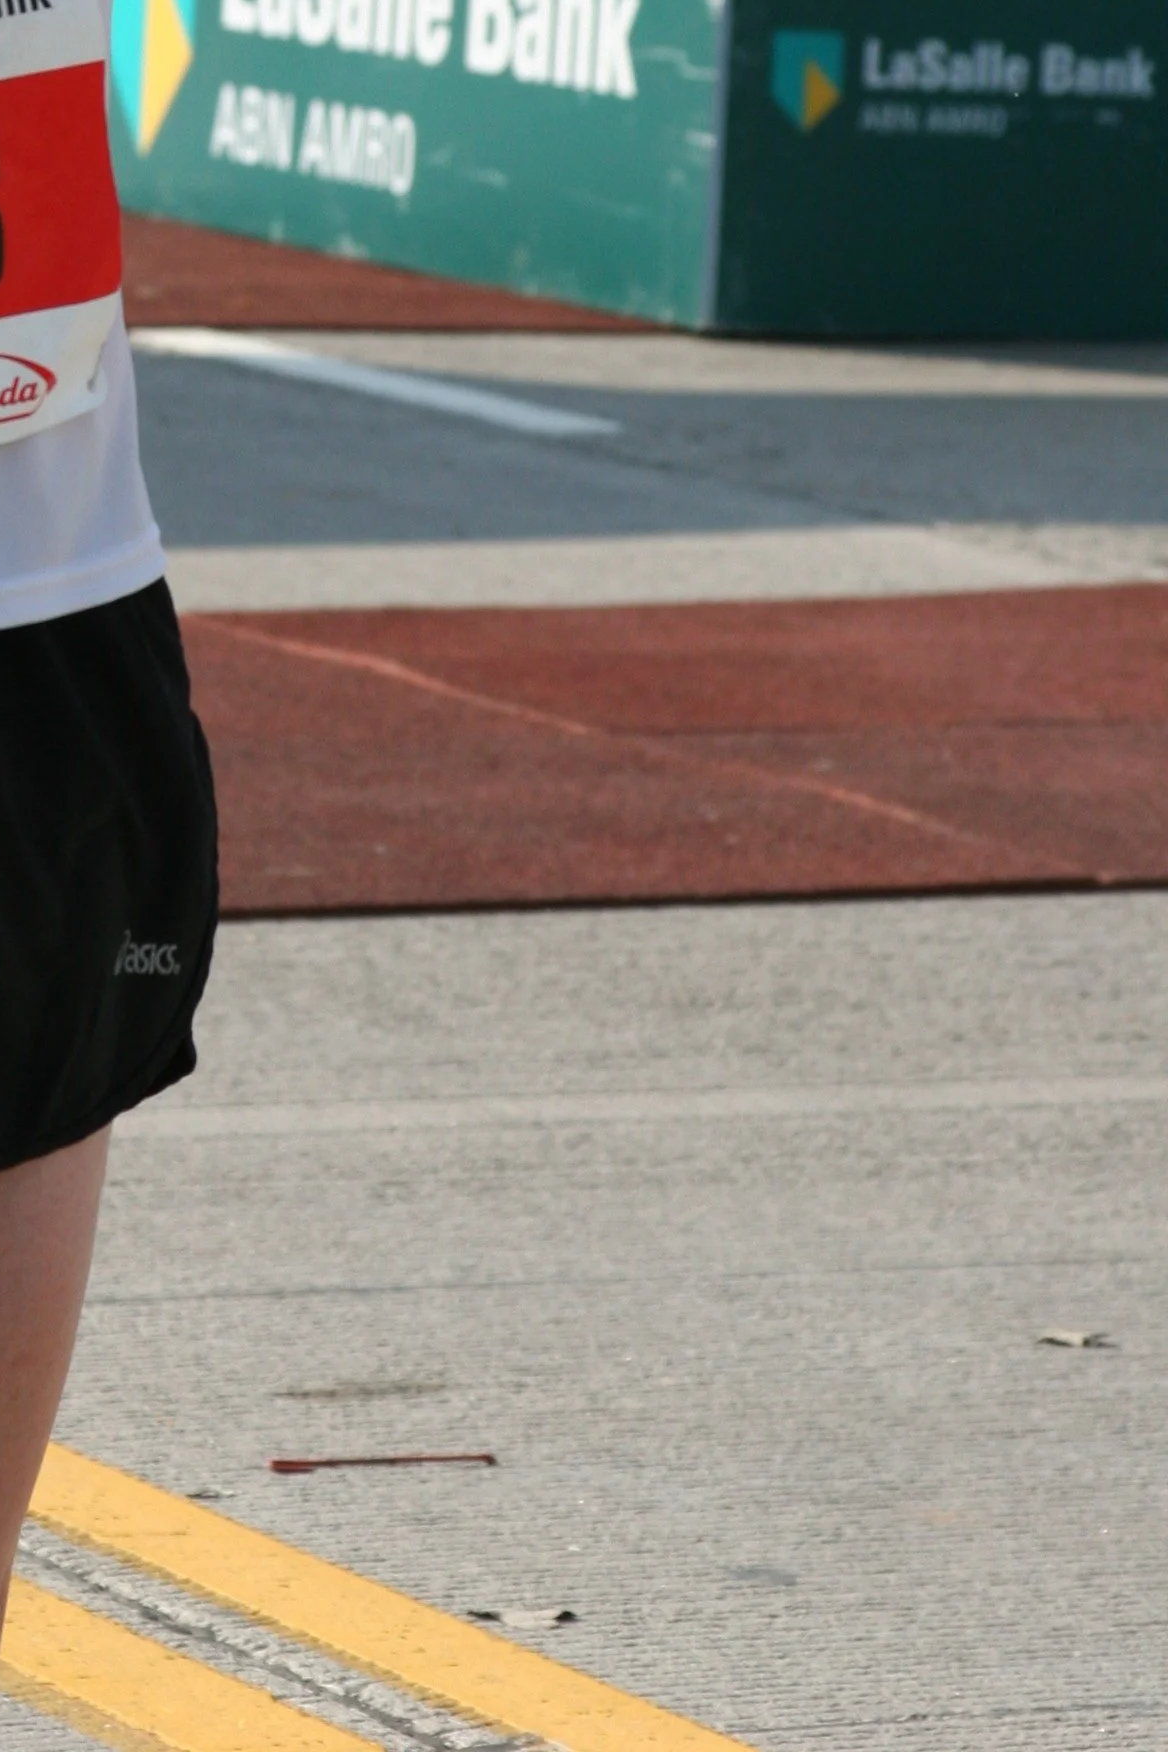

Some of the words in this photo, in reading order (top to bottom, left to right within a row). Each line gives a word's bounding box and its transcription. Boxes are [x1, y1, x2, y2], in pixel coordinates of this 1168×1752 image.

[862, 37, 1029, 95] LaSalle
[1039, 41, 1155, 100] Bank
[209, 82, 296, 170] ABN
[297, 98, 417, 195] AMRO
